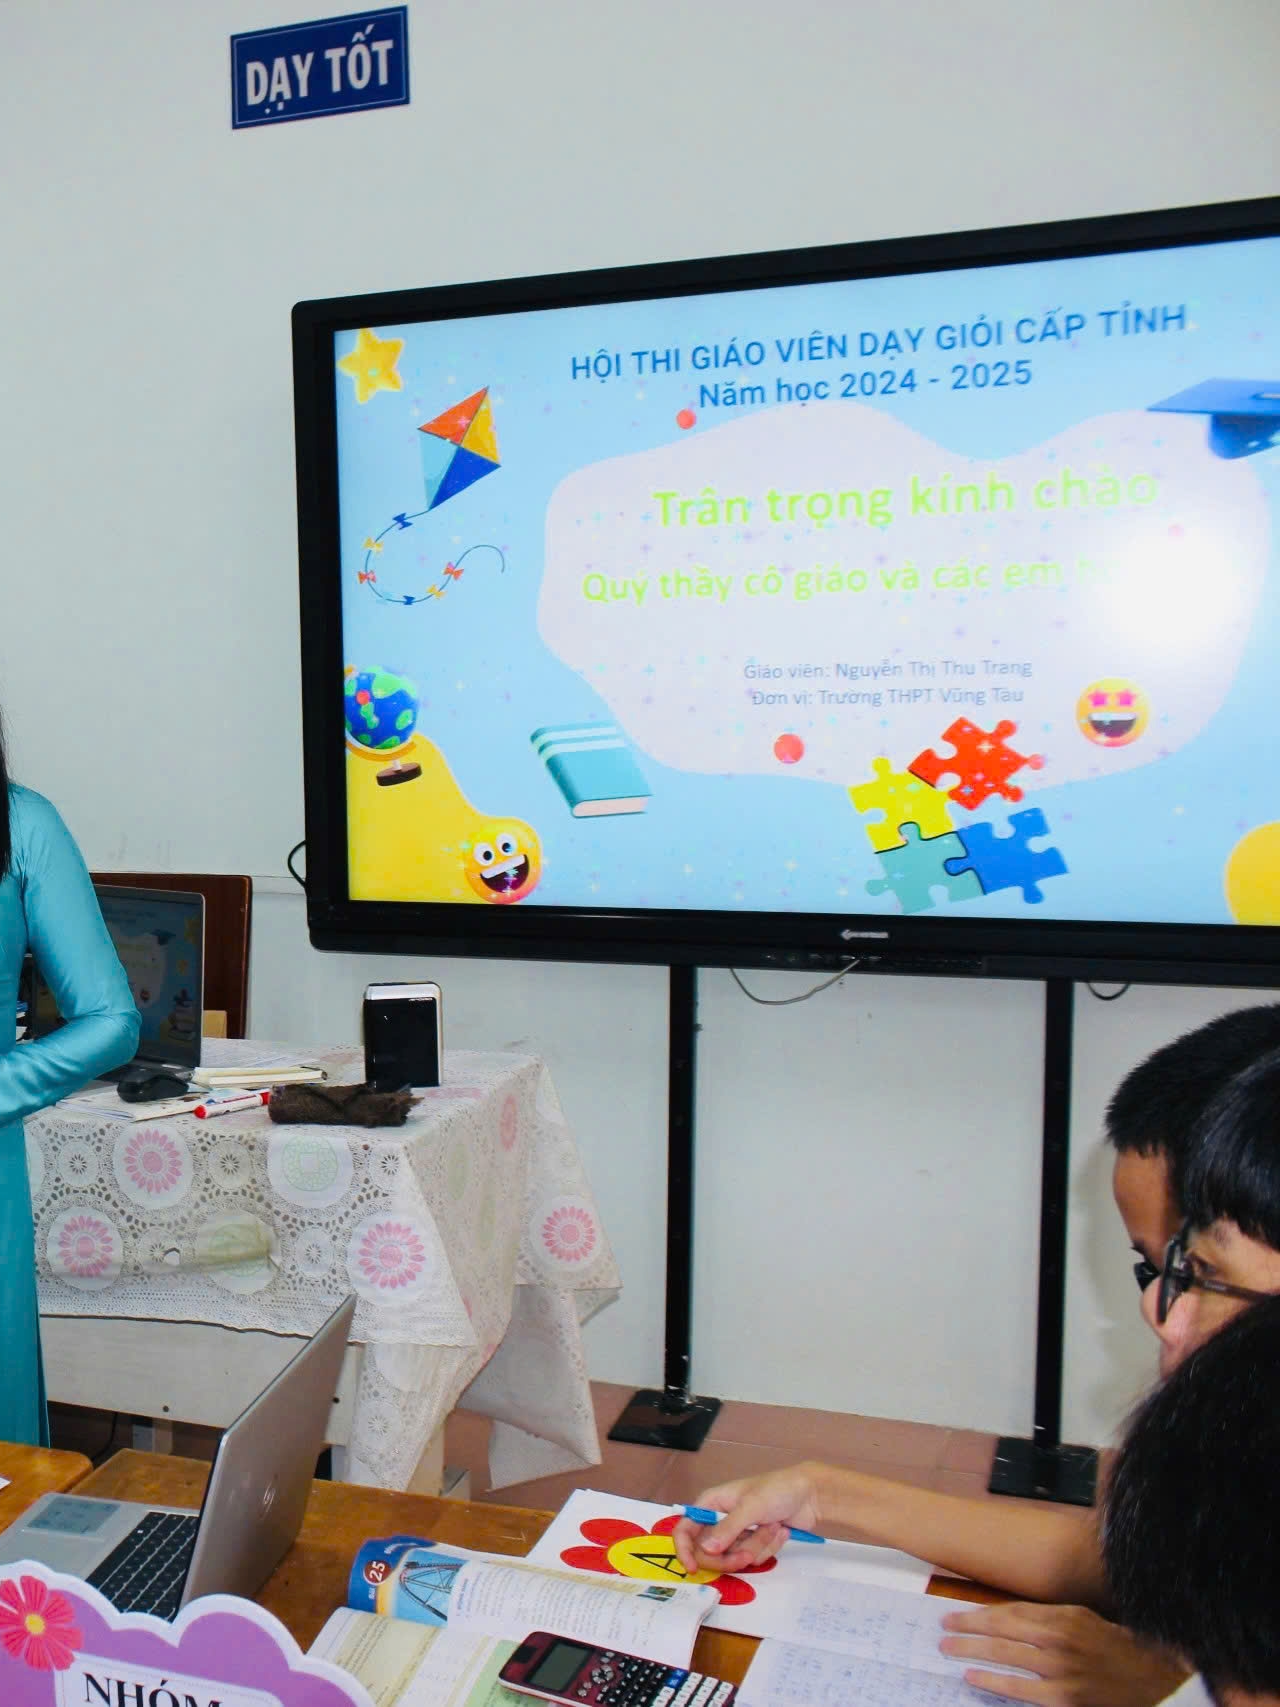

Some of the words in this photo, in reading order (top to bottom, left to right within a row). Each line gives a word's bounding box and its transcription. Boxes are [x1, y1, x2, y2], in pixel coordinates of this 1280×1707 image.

[246, 52, 315, 111] DẠY
[324, 24, 394, 93] TỐT
[571, 348, 621, 383] HỘI
[631, 348, 680, 374] THI
[691, 337, 766, 371] GIÁO
[775, 329, 847, 363] VIÊN
[859, 328, 925, 361] DẠY
[935, 314, 1003, 350] GIỎI
[1015, 306, 1086, 344] CẤP
[1097, 300, 1187, 337] TỈNH
[699, 381, 765, 408] Năm
[776, 377, 830, 407] học
[840, 367, 917, 398] 2024
[951, 359, 1033, 390] 2025
[652, 486, 751, 528] Trân
[766, 487, 894, 530] trọng
[910, 471, 1015, 516] kính
[1032, 463, 1159, 510] chào
[658, 562, 733, 604] thầy
[744, 563, 783, 596] cô
[793, 561, 869, 601] giáo
[879, 559, 920, 591] và
[932, 556, 992, 589] các
[1002, 562, 1064, 588] em
[743, 662, 783, 680] Giáo
[835, 658, 903, 681] Nguyễn
[942, 659, 975, 677] Thu
[983, 659, 1033, 678] Trang
[752, 690, 788, 706] Đơn
[888, 688, 933, 705] THPT
[369, 1560, 386, 1582] 25
